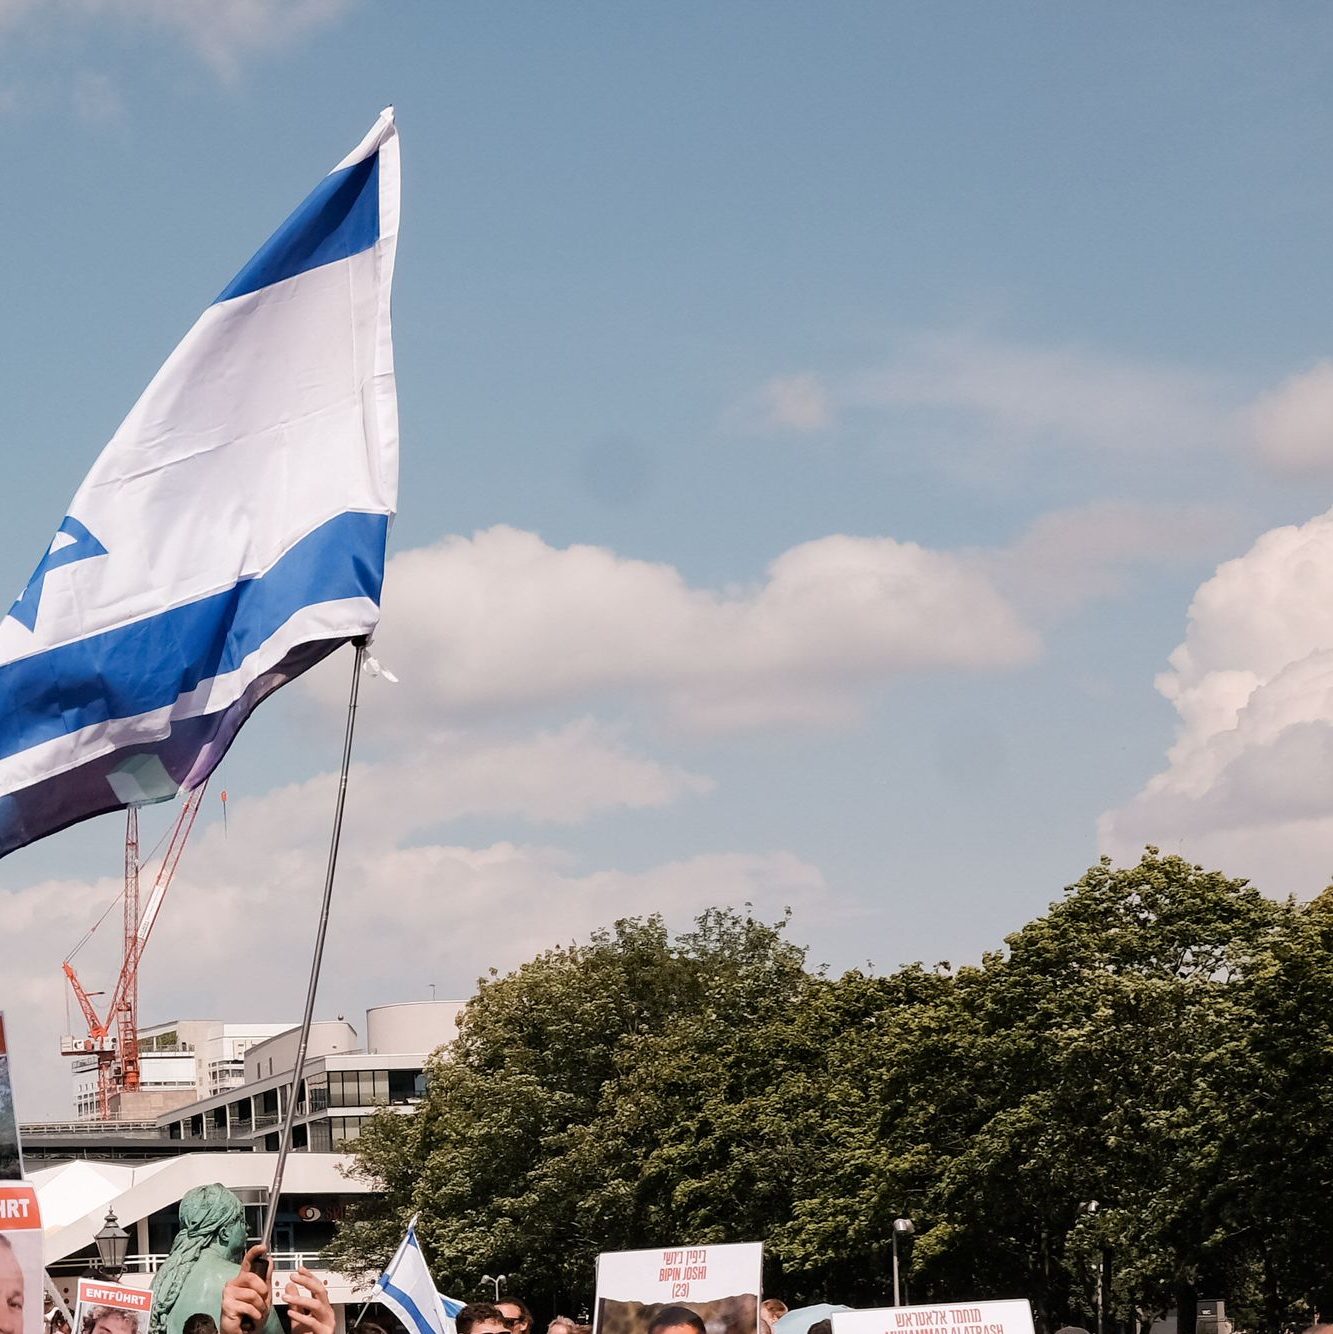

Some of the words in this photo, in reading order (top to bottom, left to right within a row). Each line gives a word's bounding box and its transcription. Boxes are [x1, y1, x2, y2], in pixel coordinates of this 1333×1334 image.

[659, 1267, 681, 1281] BIPIN
[683, 1266, 707, 1280] JOSHI
[85, 1288, 146, 1306] ENTFÜHRT
[672, 1282, 690, 1298] (23)
